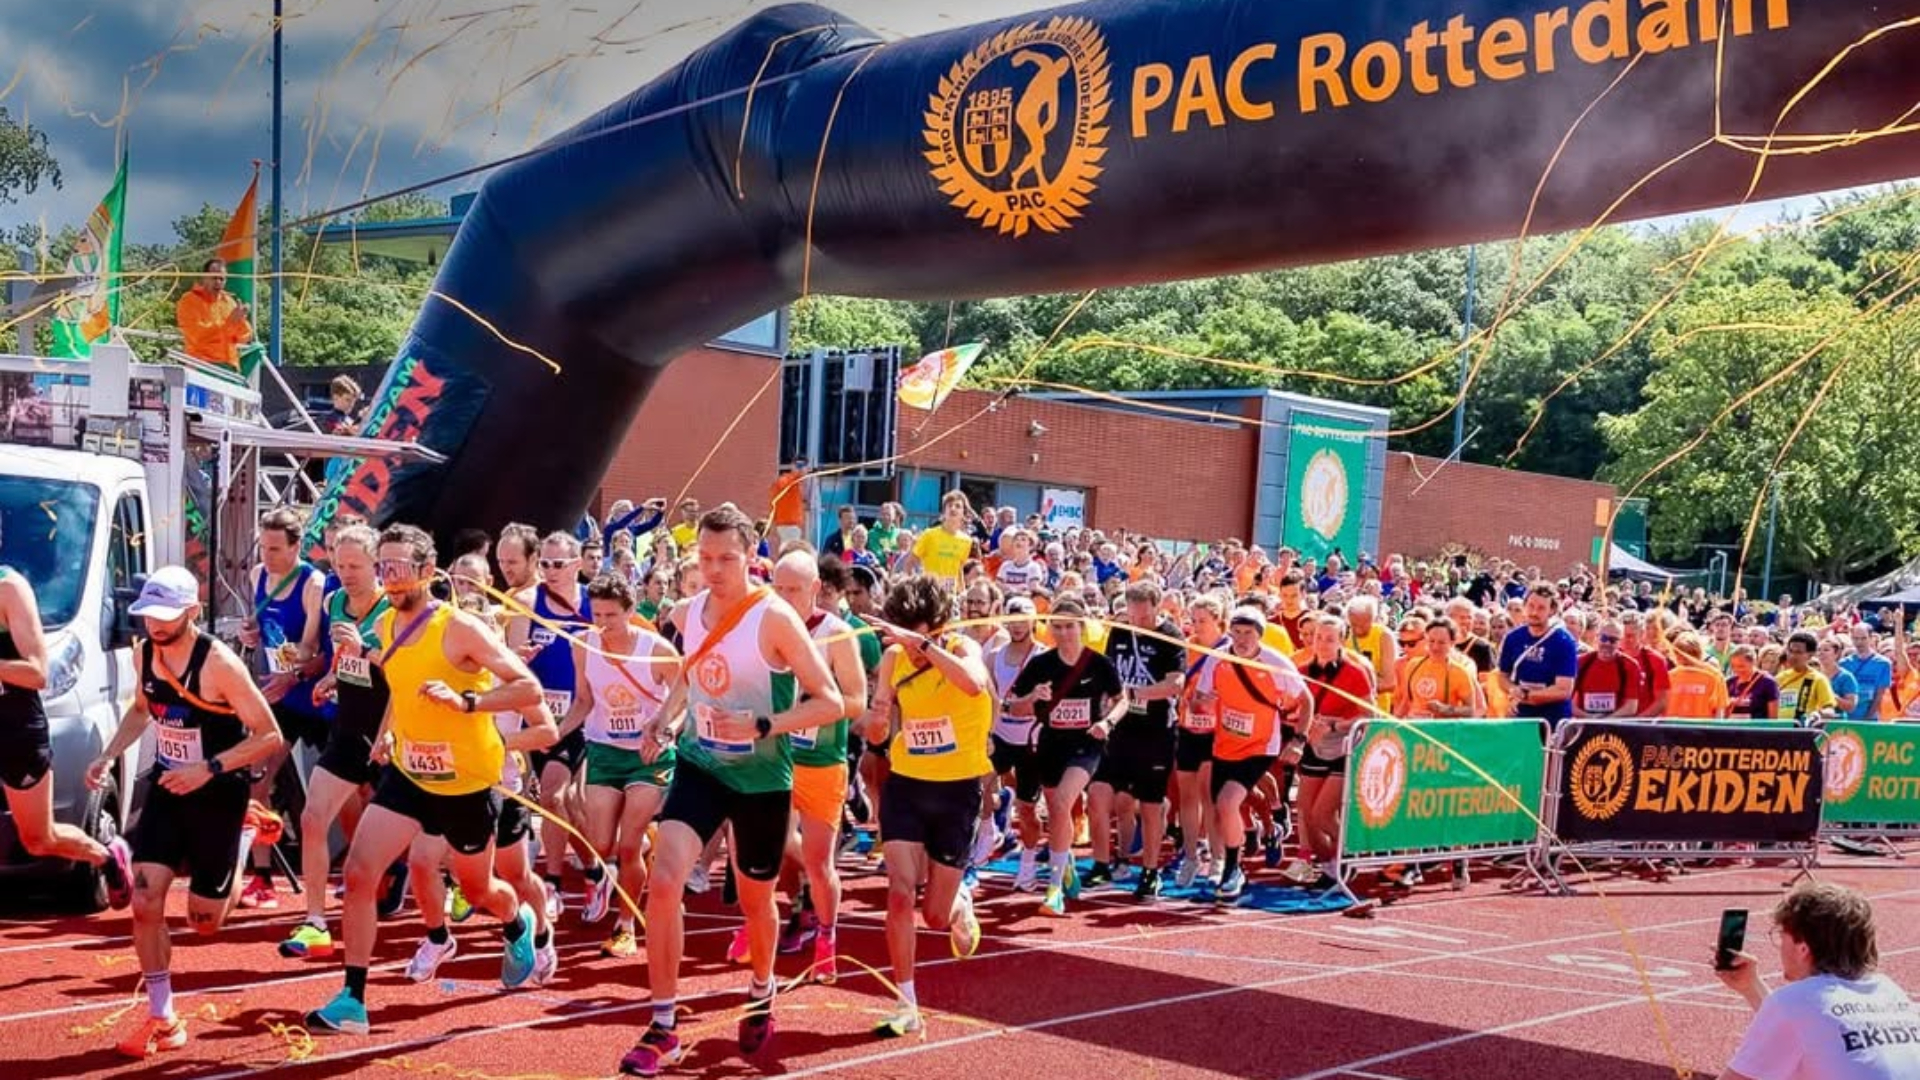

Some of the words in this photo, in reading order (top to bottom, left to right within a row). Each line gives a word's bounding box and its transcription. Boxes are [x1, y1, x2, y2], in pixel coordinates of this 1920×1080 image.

[968, 87, 1013, 108] 1895
[1049, 32, 1086, 62] LUDERE
[1075, 65, 1092, 148] VIDEMUR
[1131, 43, 1277, 138] PAC
[1006, 191, 1046, 211] PAC
[609, 717, 636, 731] 1011
[1055, 708, 1083, 720] 2021
[911, 730, 943, 746] 1371
[1411, 742, 1449, 772] PAC
[1872, 741, 1914, 765] PAC
[1406, 783, 1522, 819] ROTTERDAM
[1634, 769, 1811, 813] EKIDEN
